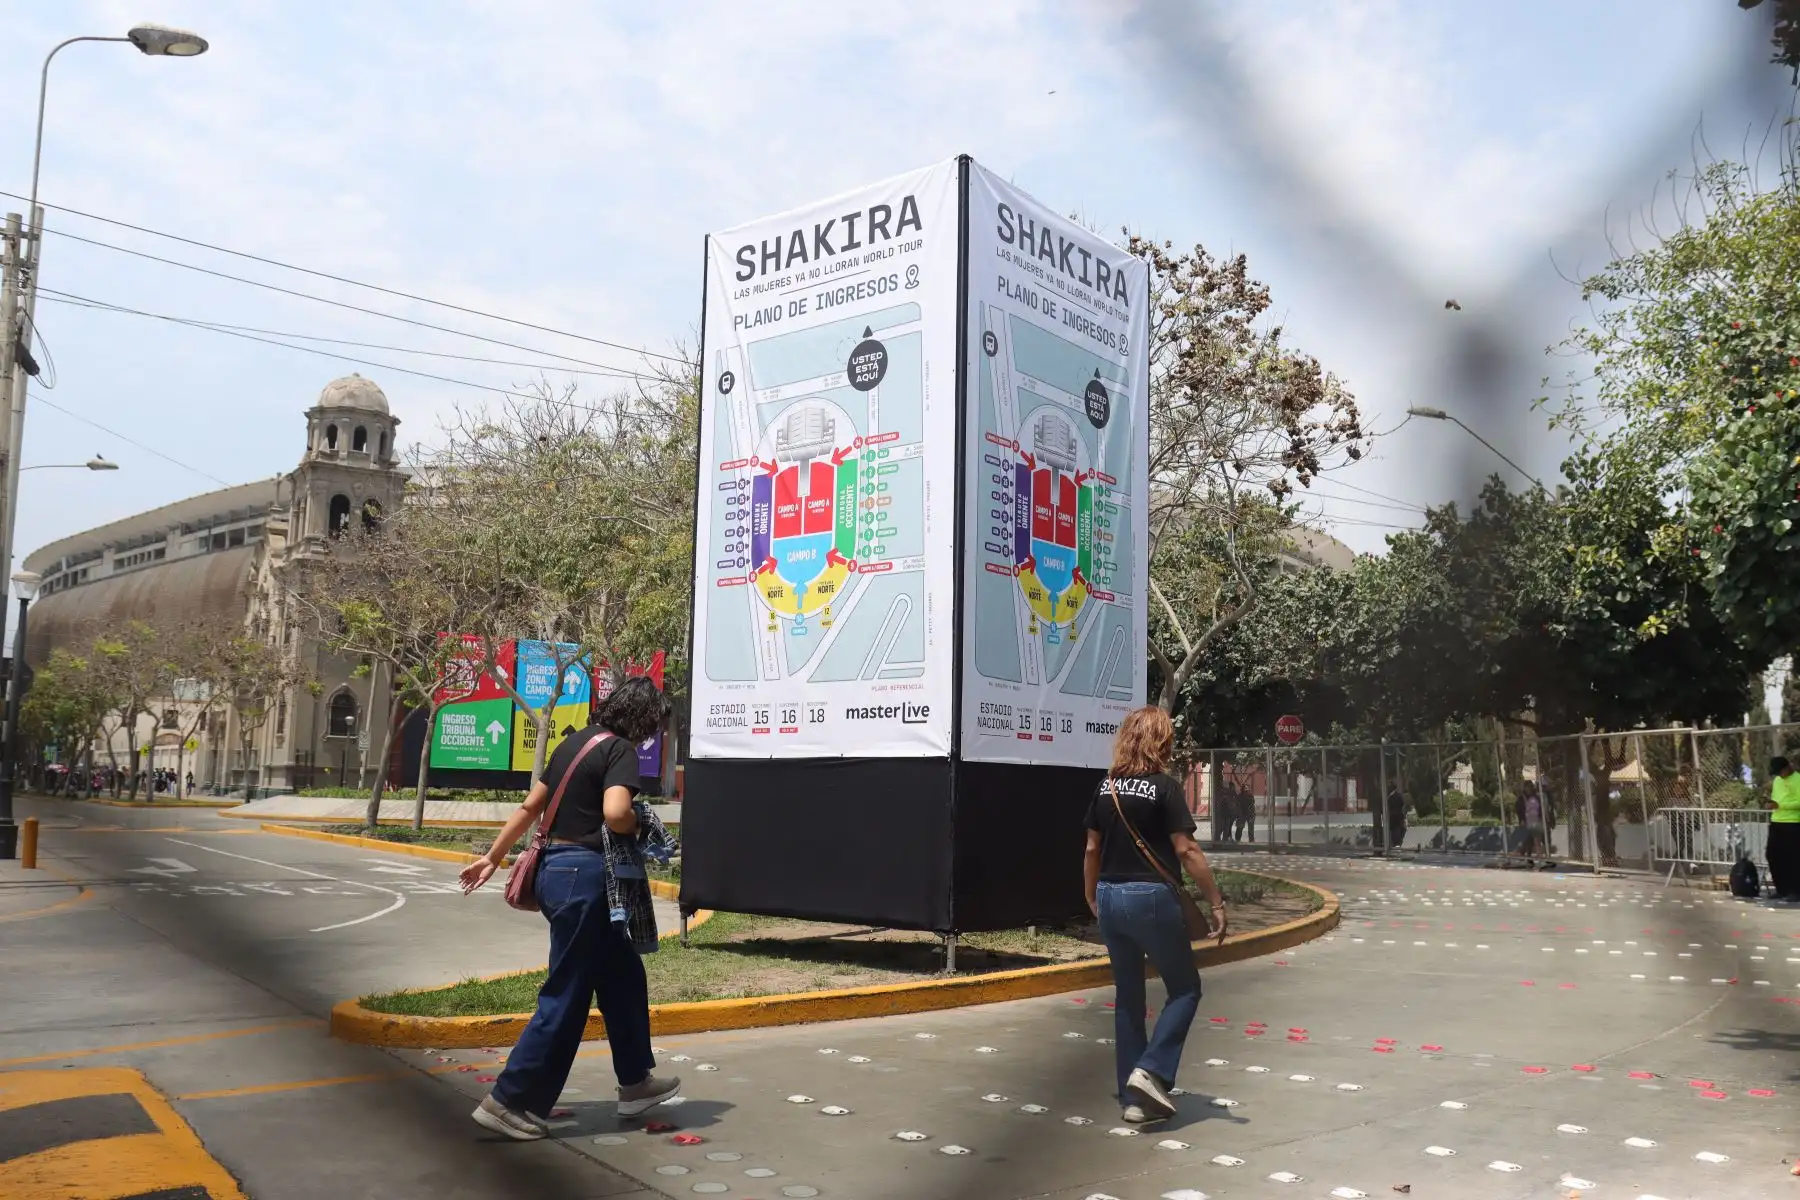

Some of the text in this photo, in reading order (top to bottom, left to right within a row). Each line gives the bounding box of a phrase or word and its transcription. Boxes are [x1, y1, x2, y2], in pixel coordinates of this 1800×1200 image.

[736, 195, 922, 282] SHAKIRA
[997, 202, 1129, 307] SHAKIRA
[734, 239, 923, 300] LAS MUJERES YA NO LLORAN WORLD TOUR
[996, 246, 1130, 324] LAS MUJERES YA NO LLORAN WORLD TOUR
[734, 274, 898, 331] PLANO DE INGRESOS
[998, 275, 1116, 349] PLANO DE INGRESOS
[852, 351, 883, 365] USTED
[855, 360, 879, 374] ESTÁ
[856, 370, 879, 384] AQUÍ
[1087, 390, 1107, 405] USTED
[1089, 401, 1105, 413] ESTÁ
[777, 504, 799, 514] CAMPO A
[808, 498, 830, 509] CAMPO A
[845, 483, 855, 528] OCCIDENTE
[1035, 506, 1048, 516] CAMPO
[1057, 512, 1070, 522] CAMPO
[760, 502, 769, 535] ORIENTE
[1084, 509, 1092, 552] OCCIDENTE
[787, 550, 817, 562] CAMPO B
[1043, 557, 1061, 569] CAMPO
[767, 589, 784, 598] NORTE
[818, 584, 835, 594] NORTE
[526, 664, 559, 676] INGRESO
[526, 674, 547, 685] ZONA
[525, 684, 553, 696] CAMPO
[710, 703, 746, 715] ESTADIO
[809, 708, 825, 724] 18
[980, 702, 1012, 716] ESTADIO
[442, 713, 476, 725] INGRESO
[706, 716, 749, 729] NACIONAL
[754, 710, 769, 725] 15
[781, 709, 797, 725] 16
[977, 716, 1014, 731] NACIONAL
[1019, 714, 1031, 730] 15
[1040, 716, 1052, 732] 16
[442, 724, 476, 736] TRIBUNA
[1061, 719, 1073, 734] 18
[1277, 724, 1301, 734] PARE
[441, 734, 485, 747] OCCIDENTE
